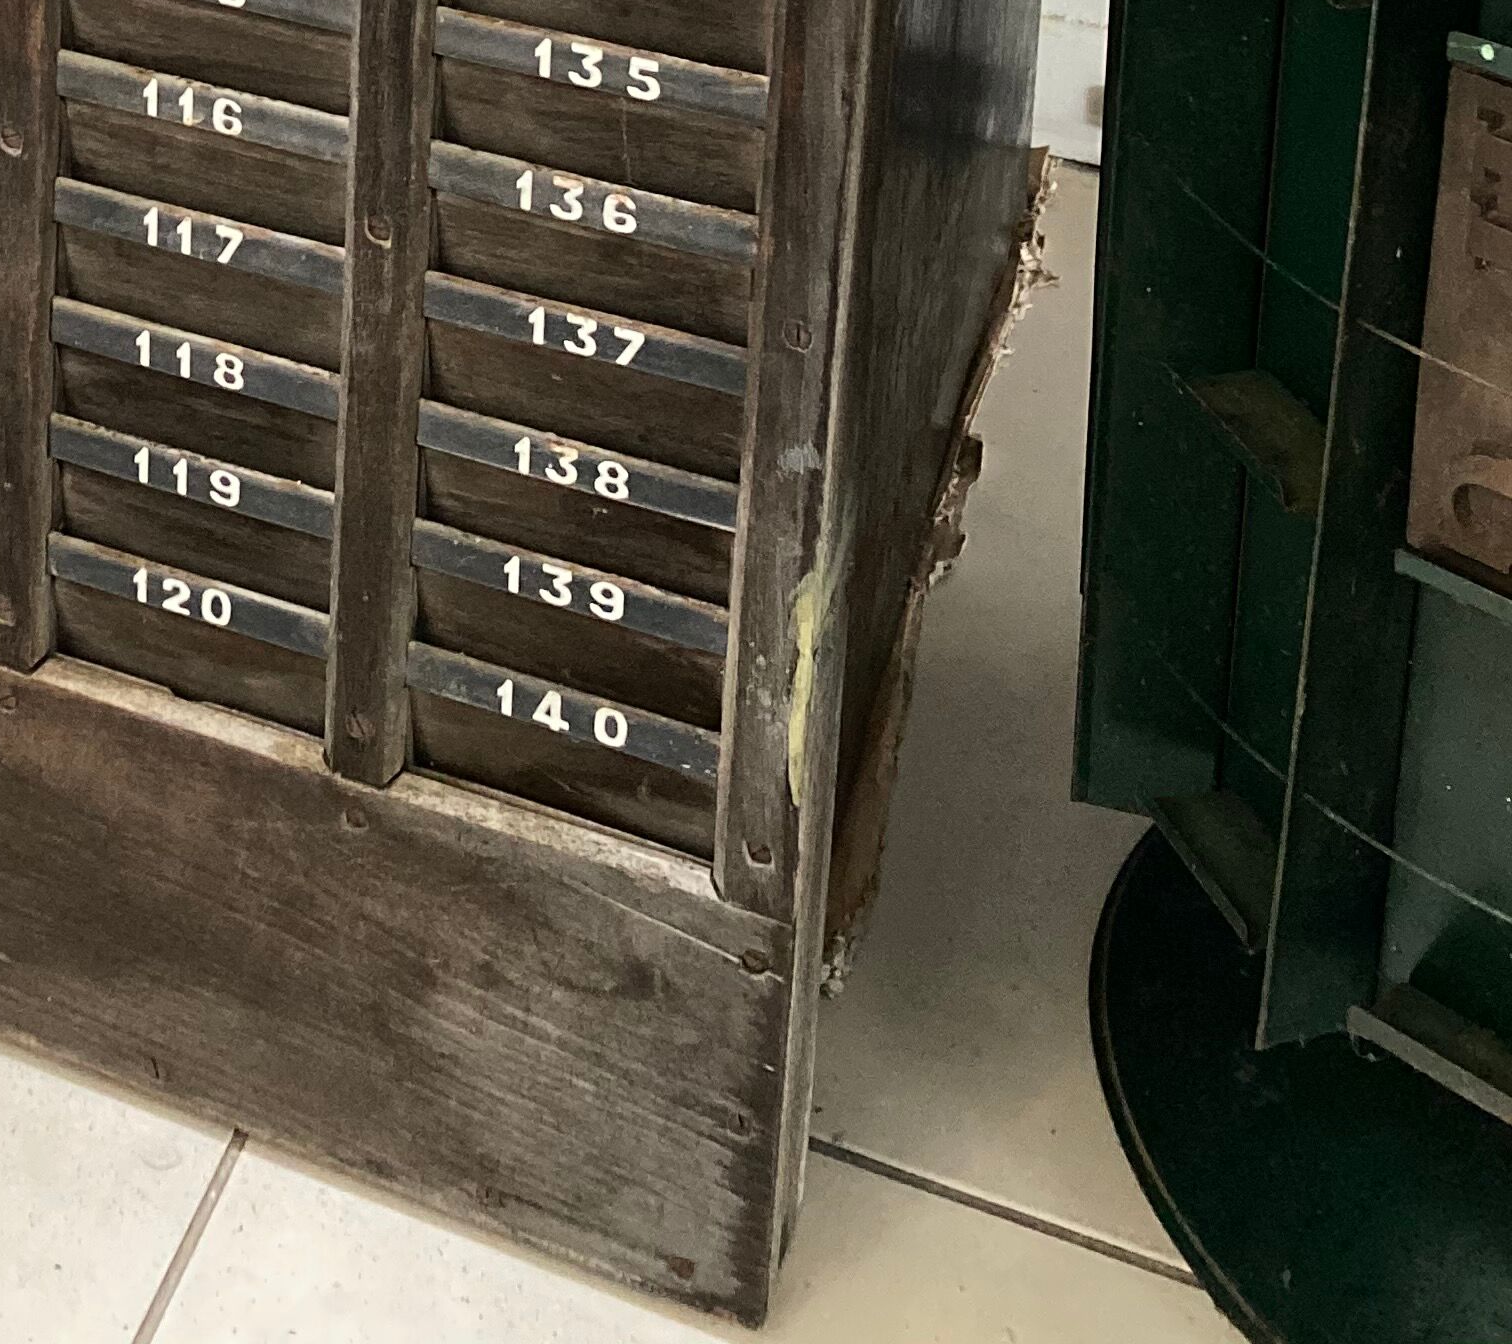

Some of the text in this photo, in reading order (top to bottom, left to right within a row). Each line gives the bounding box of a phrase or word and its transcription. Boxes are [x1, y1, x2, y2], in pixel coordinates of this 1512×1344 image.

[534, 38, 661, 101] 135
[142, 79, 243, 136] 116
[516, 169, 637, 234] 136
[135, 330, 244, 391] 118
[133, 447, 241, 508] 119
[514, 436, 630, 500] 138
[132, 568, 232, 627] 120
[503, 556, 625, 622] 139
[496, 679, 628, 748] 140
